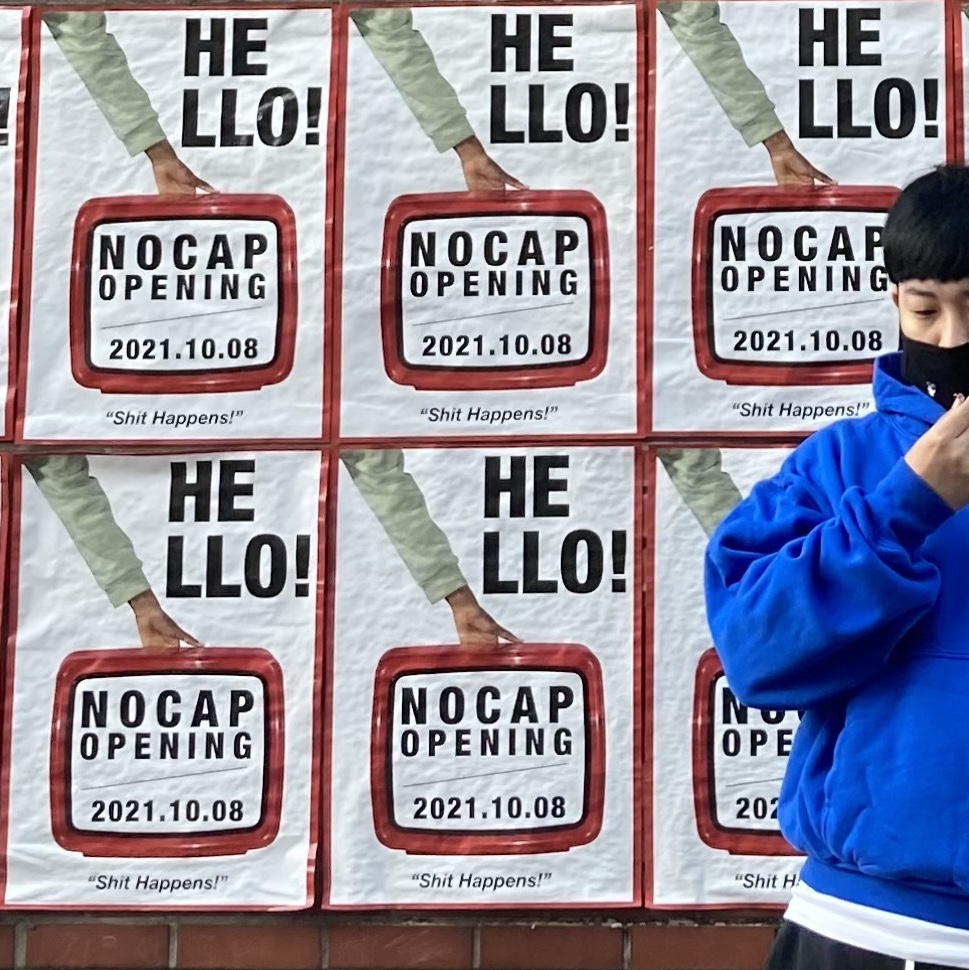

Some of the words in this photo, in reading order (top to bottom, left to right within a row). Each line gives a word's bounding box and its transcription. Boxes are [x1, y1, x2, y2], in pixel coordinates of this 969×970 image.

[183, 17, 268, 77] HE
[490, 13, 574, 73] HE
[798, 7, 882, 67] HE
[181, 86, 322, 148] LLO!
[489, 82, 630, 145] LLO!
[798, 77, 939, 140] LLO!
[99, 233, 268, 271] NOCAP
[411, 230, 579, 267] NOCAP
[721, 225, 884, 261] NOCAP
[98, 273, 266, 301] OPENING
[410, 269, 578, 298] OPENING
[721, 265, 888, 292] OPENING
[109, 337, 258, 360] 2021.10.08
[422, 333, 573, 357] 2021.10.08
[733, 330, 883, 351] 2021.10.08
[168, 459, 256, 523] HE
[483, 454, 570, 519] HE
[165, 533, 311, 599] LLO!
[482, 529, 627, 595] LLO!
[81, 690, 254, 729] NOCAP
[402, 686, 574, 725] NOCAP
[80, 731, 252, 761] OPENING
[400, 727, 572, 757] OPENING
[91, 799, 244, 822] 2021.10.08
[413, 795, 566, 820] 2021.10.08
